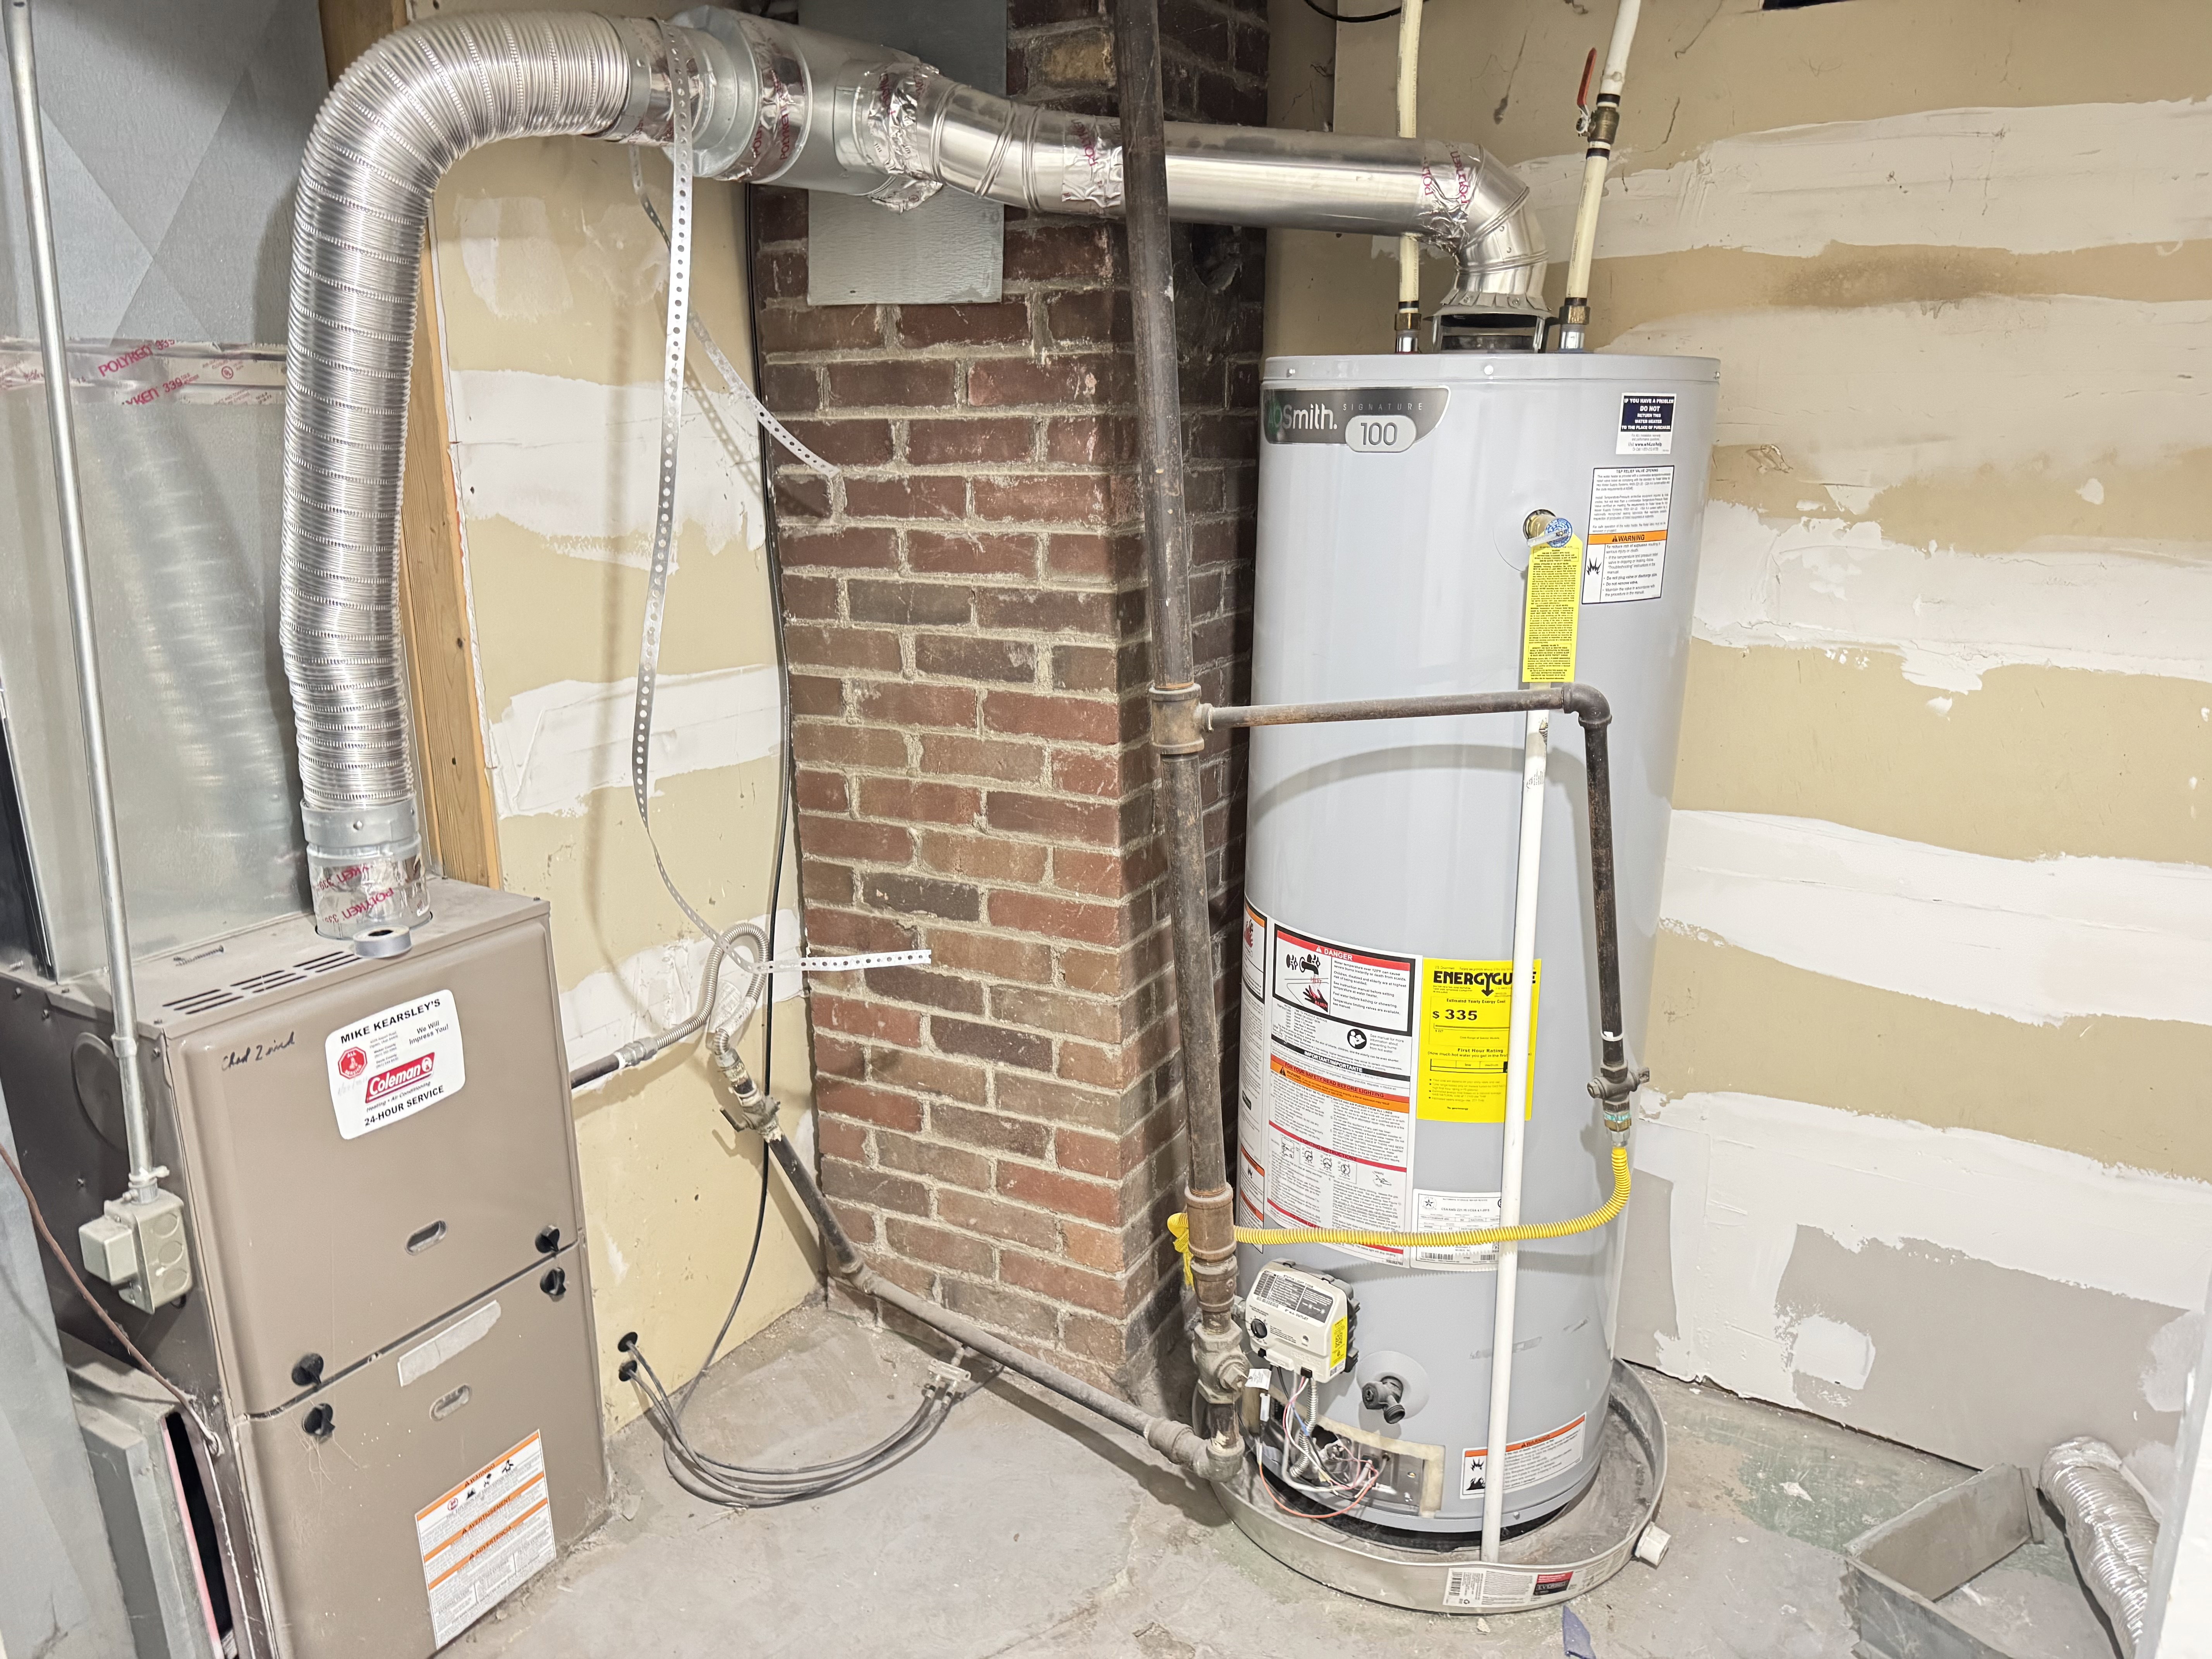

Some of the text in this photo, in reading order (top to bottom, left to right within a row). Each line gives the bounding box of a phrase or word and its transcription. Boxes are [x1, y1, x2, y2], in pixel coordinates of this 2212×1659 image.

[98, 343, 153, 376] POLYKEN
[163, 377, 183, 393] 339
[1361, 422, 1398, 446] 100
[343, 888, 394, 919] POLYKEN
[1324, 948, 1353, 961] DANGER
[341, 999, 440, 1044] MIKE KEARSLEY'S
[428, 1020, 440, 1030] Will
[1445, 1009, 1477, 1020] 335
[409, 1024, 448, 1045] Impress You!
[1304, 1051, 1362, 1072] IMPORTANT/IMPORTANTE
[370, 1065, 421, 1095] Coleman
[1293, 1066, 1305, 1074] YOUR
[1305, 1071, 1322, 1081] SAFETY
[1338, 1082, 1358, 1091] BEFORE
[1359, 1089, 1384, 1097] LIGHTING
[364, 1085, 444, 1126] 24-HOUR SERVICE
[366, 1100, 386, 1112] Heating
[399, 1082, 431, 1098] Conditioning
